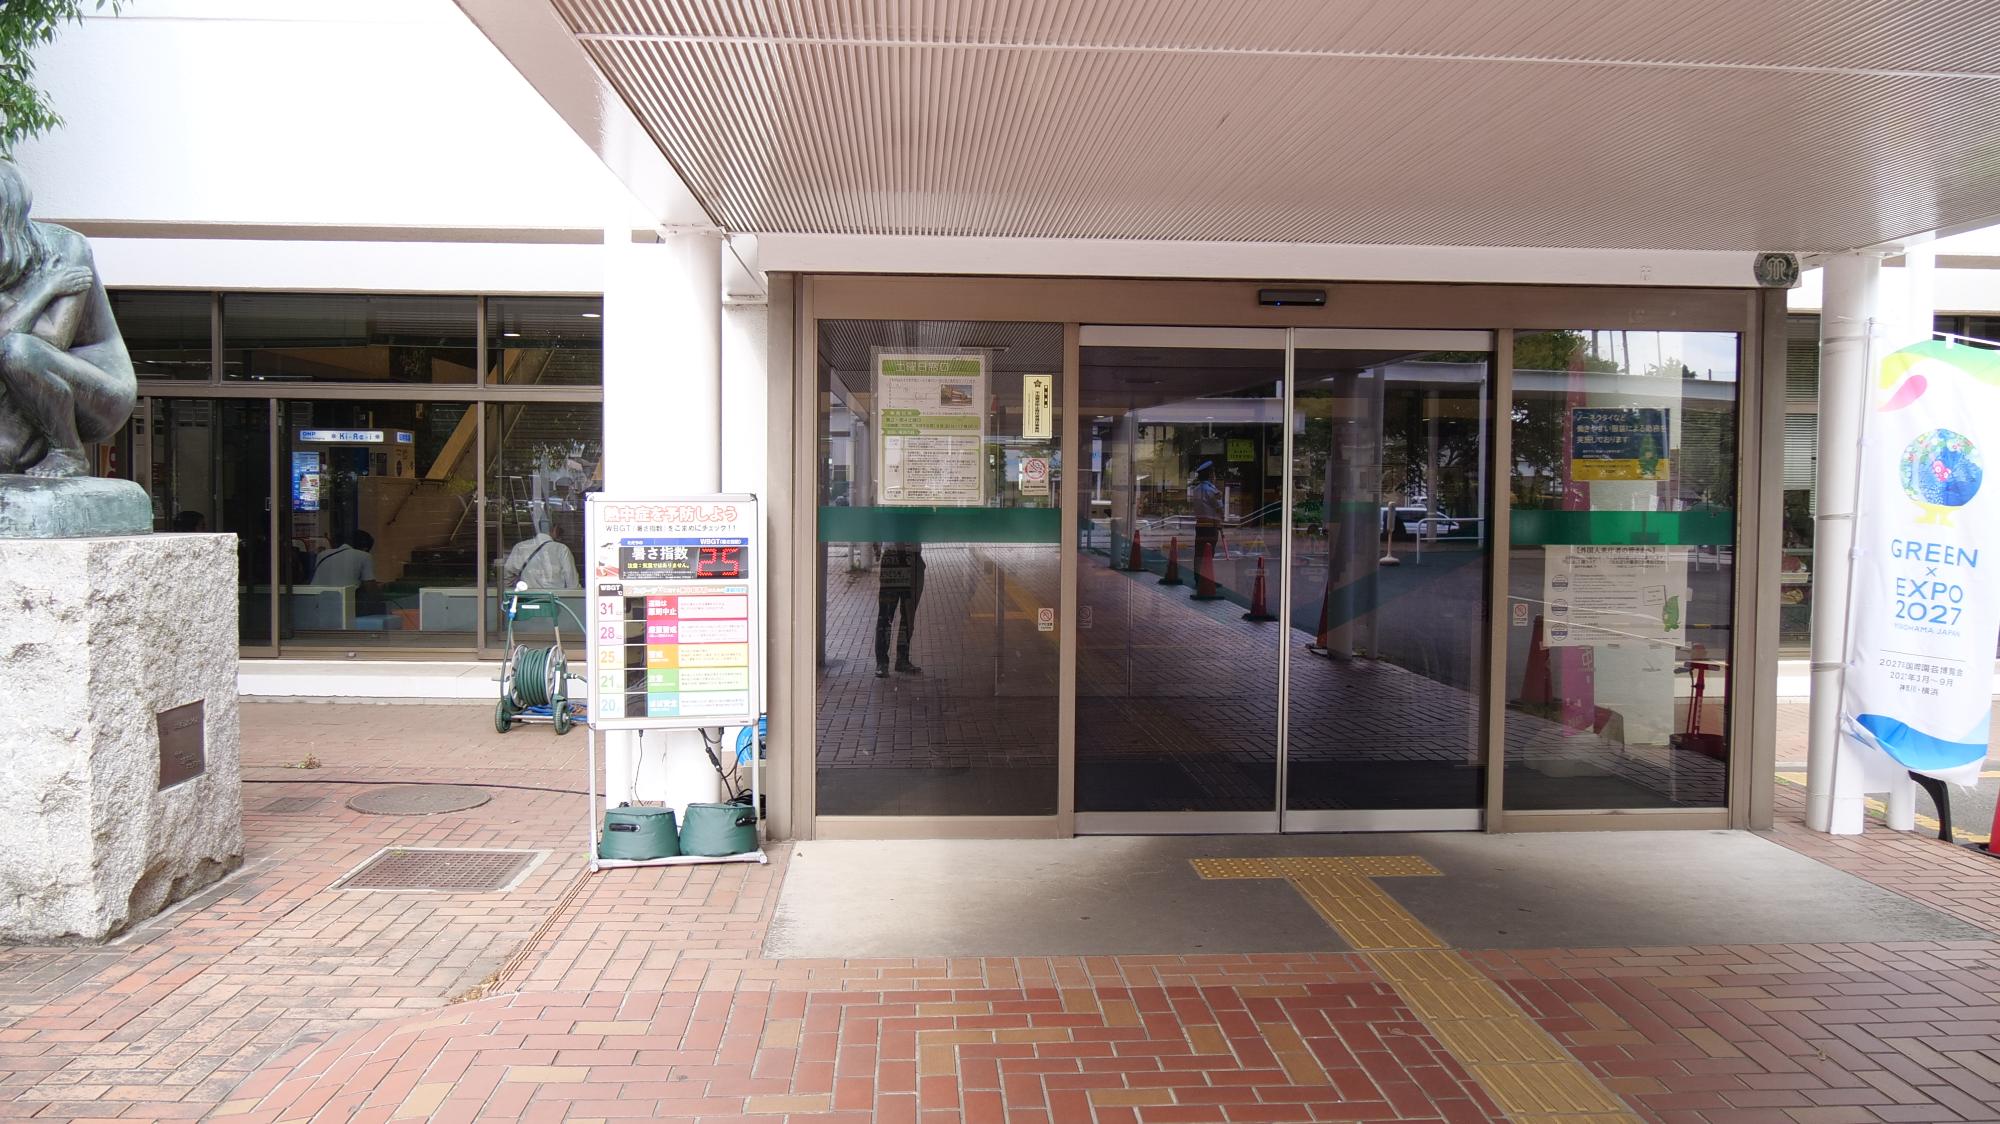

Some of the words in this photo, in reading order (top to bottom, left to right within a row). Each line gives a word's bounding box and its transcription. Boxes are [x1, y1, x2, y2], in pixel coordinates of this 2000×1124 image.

[1576, 414, 1627, 422] ノーネクタイなど
[603, 505, 738, 522] 熱中症を予防しよう
[632, 545, 688, 560] 暑さ指数
[1890, 539, 1979, 568] GREEN
[697, 548, 739, 576] 25
[1896, 577, 1963, 604] EXPO
[600, 602, 614, 615] 31
[1895, 600, 1962, 626] 2027
[600, 627, 615, 639] 28
[1936, 628, 1961, 638] JAPAN
[600, 650, 615, 663] 25
[600, 675, 614, 688] 21
[601, 699, 616, 712] 20
